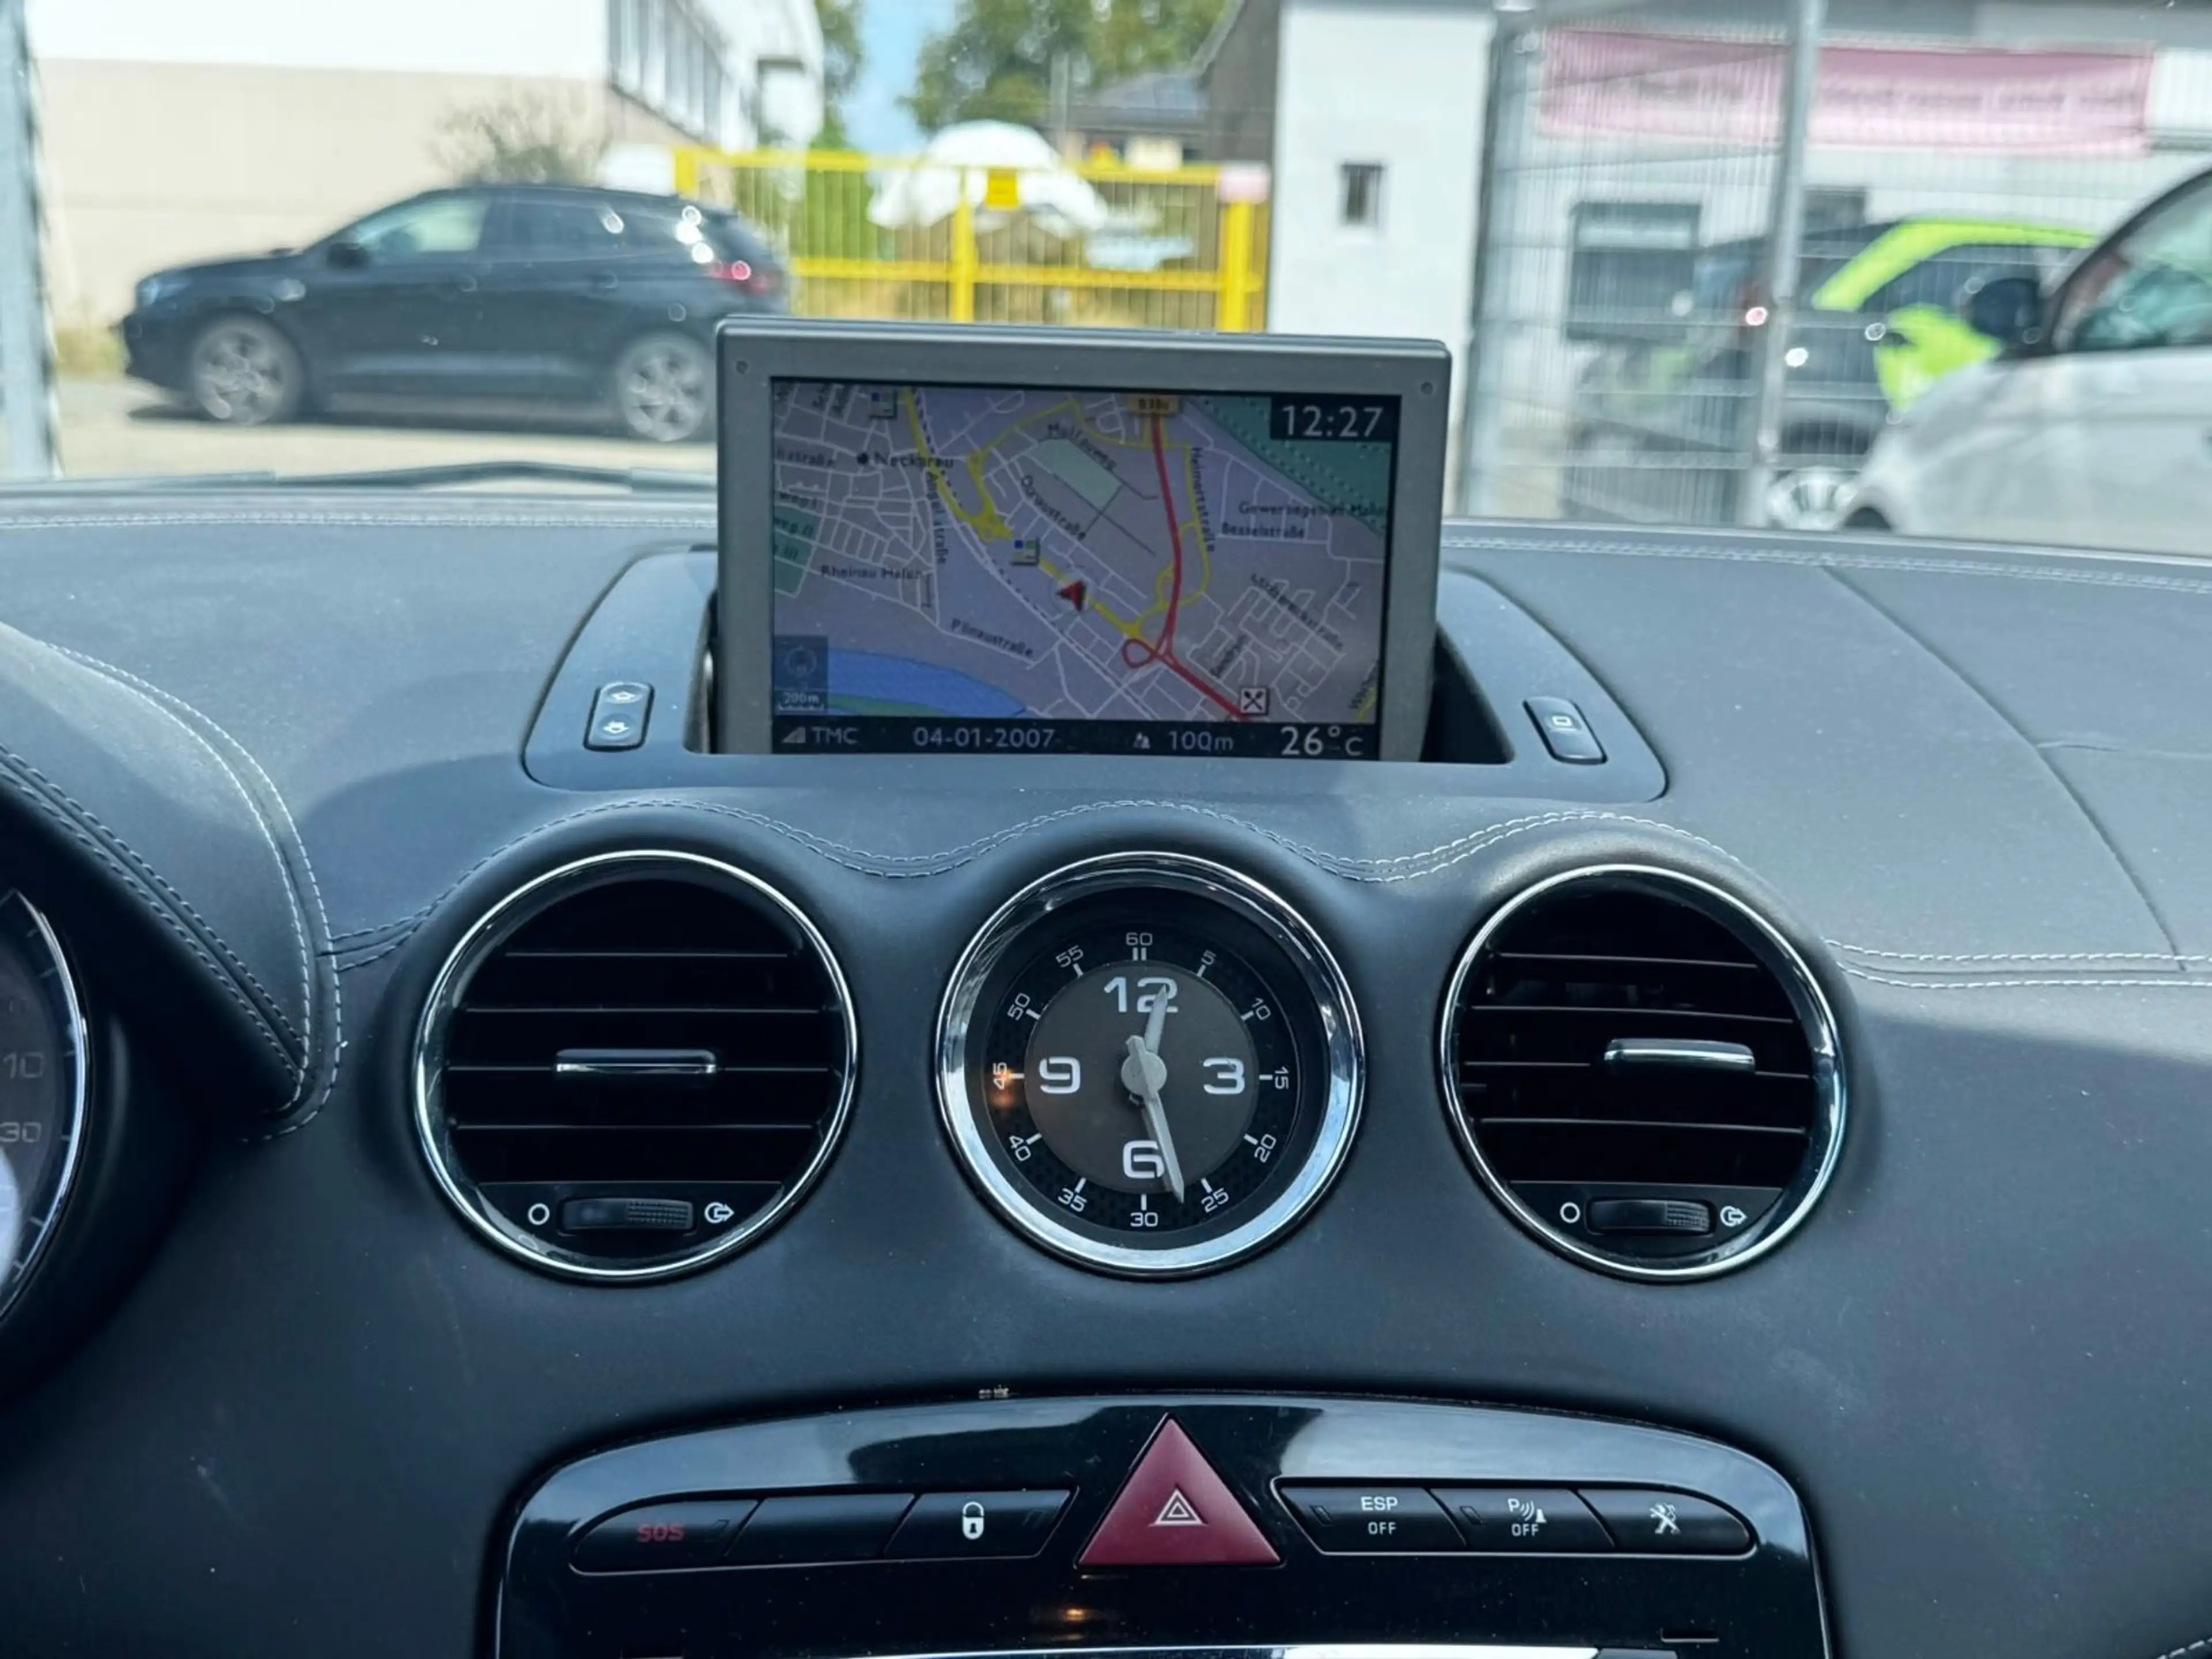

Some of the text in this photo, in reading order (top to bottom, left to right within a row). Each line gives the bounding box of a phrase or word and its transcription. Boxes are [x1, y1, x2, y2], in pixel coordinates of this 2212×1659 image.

[1282, 406, 1384, 437] 12:27
[812, 726, 859, 744] TMC
[913, 727, 1055, 748] 04-01-2007
[1169, 731, 1234, 751] 100m
[1126, 932, 1153, 946] 60
[1055, 946, 1084, 968] 55
[1200, 950, 1216, 965] 5
[1104, 976, 1179, 1013] 12
[1007, 993, 1031, 1020] 50
[1249, 998, 1271, 1021] 10
[993, 1062, 1007, 1090] 45
[1039, 1056, 1081, 1094] 9
[1203, 1058, 1245, 1094] 3
[1274, 1066, 1289, 1090] 15
[1008, 1135, 1032, 1162] 40
[1123, 1140, 1164, 1178] 6
[1254, 1134, 1277, 1162] 20
[1057, 1188, 1088, 1212] 35
[1201, 1188, 1229, 1213] 25
[1130, 1212, 1158, 1226] 30
[1361, 1496, 1398, 1512] ESP
[1508, 1498, 1520, 1513] P
[637, 1522, 684, 1543] SOS
[1368, 1521, 1396, 1536] OFF
[1512, 1522, 1539, 1537] OFF
